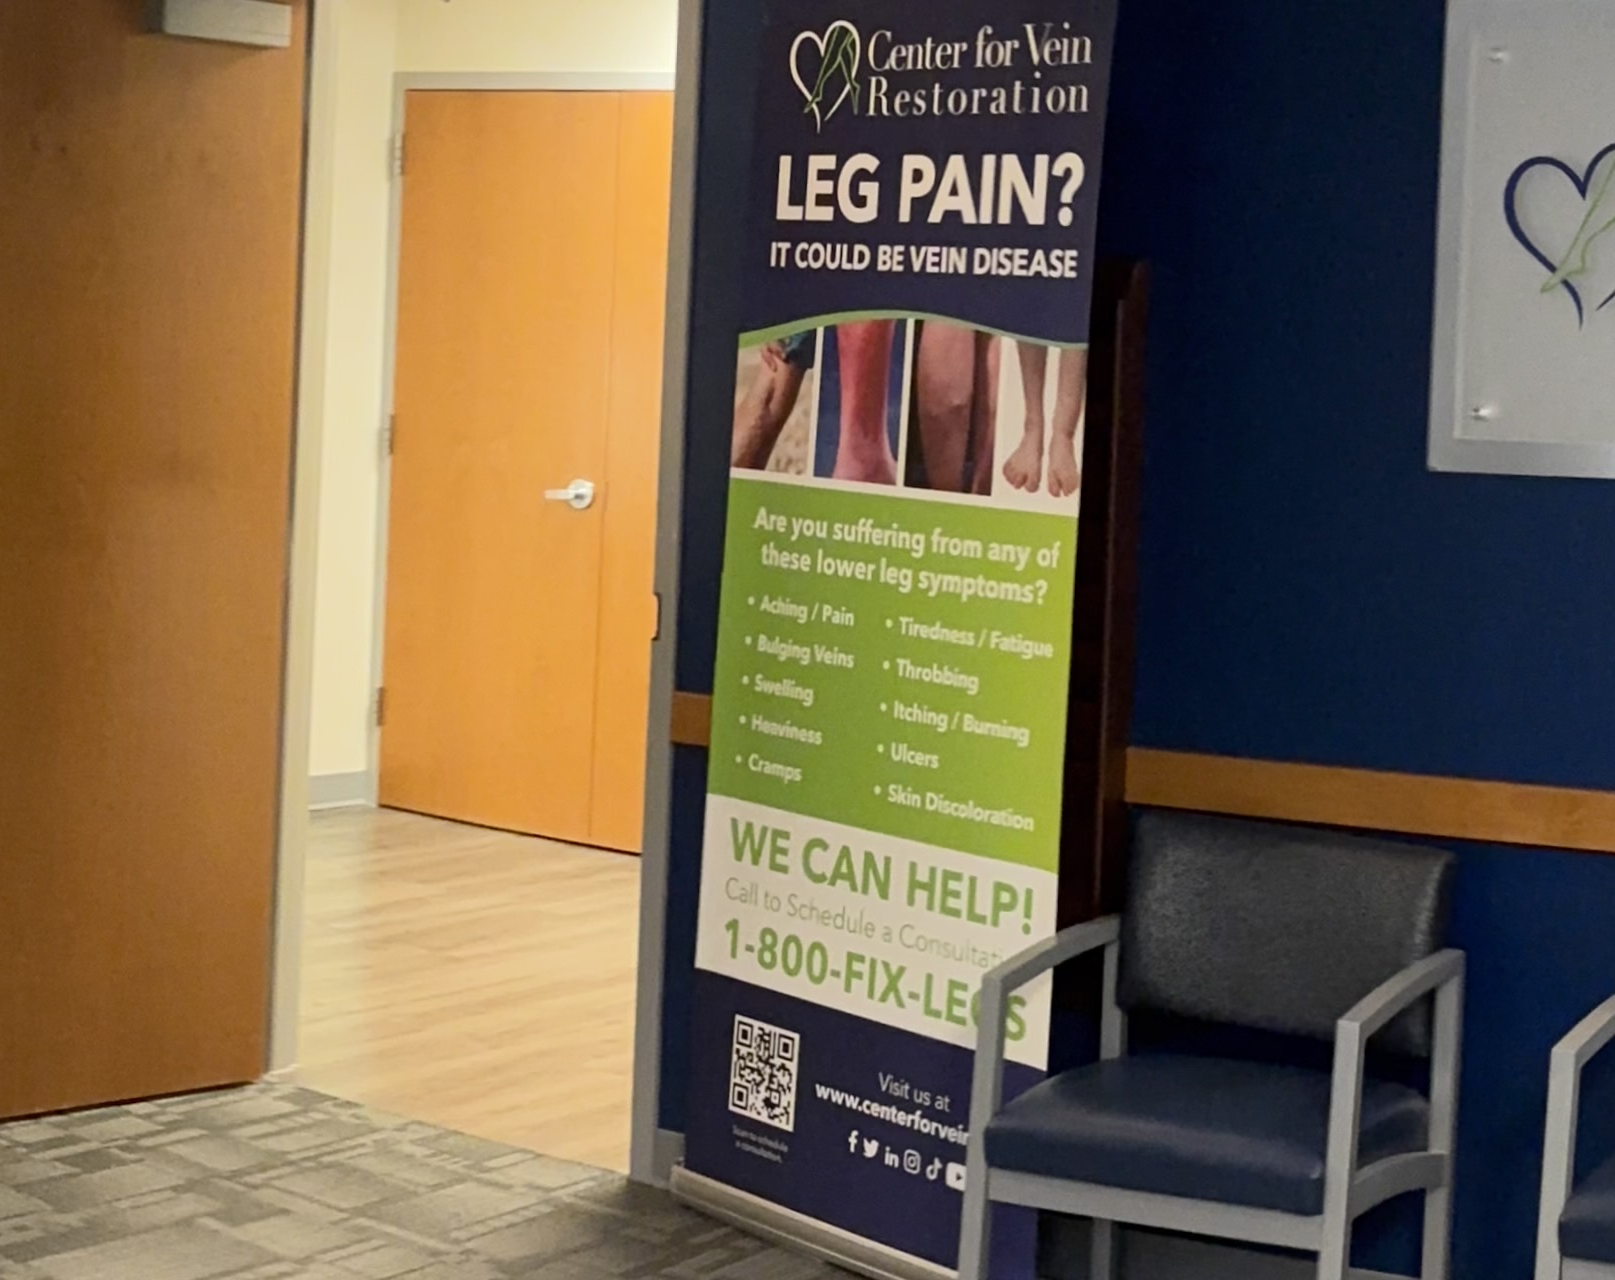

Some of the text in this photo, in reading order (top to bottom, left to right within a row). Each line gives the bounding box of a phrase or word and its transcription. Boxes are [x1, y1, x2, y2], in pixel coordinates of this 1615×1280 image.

[867, 22, 1092, 71] Center for Vein
[866, 71, 1089, 117] Restoration
[775, 151, 1085, 227] LEG PAIN?
[770, 241, 1078, 279] IT COULD BE VEIN DISEASE
[752, 506, 1061, 571] Are you suffering from any of
[760, 542, 1049, 605] these lower leg symptoms?
[759, 594, 808, 624] Aching
[822, 604, 855, 627] Pain
[757, 633, 855, 668] Bulging Veins
[899, 616, 975, 647] Tiredness
[990, 631, 1054, 660] Fatigue
[754, 673, 814, 707] Swelling
[896, 658, 980, 695] Throbbing
[751, 714, 822, 745] Heaviness
[893, 700, 948, 733] Itching
[962, 713, 1030, 748] Burning
[747, 753, 802, 784] Cramps
[890, 742, 939, 769] Ulcers
[887, 783, 1034, 831] Skin Discoloration
[730, 816, 1033, 936] WE CAN HELP!
[725, 877, 1003, 969] Call to Schedule a Consultat
[878, 1071, 951, 1112] Visit us at
